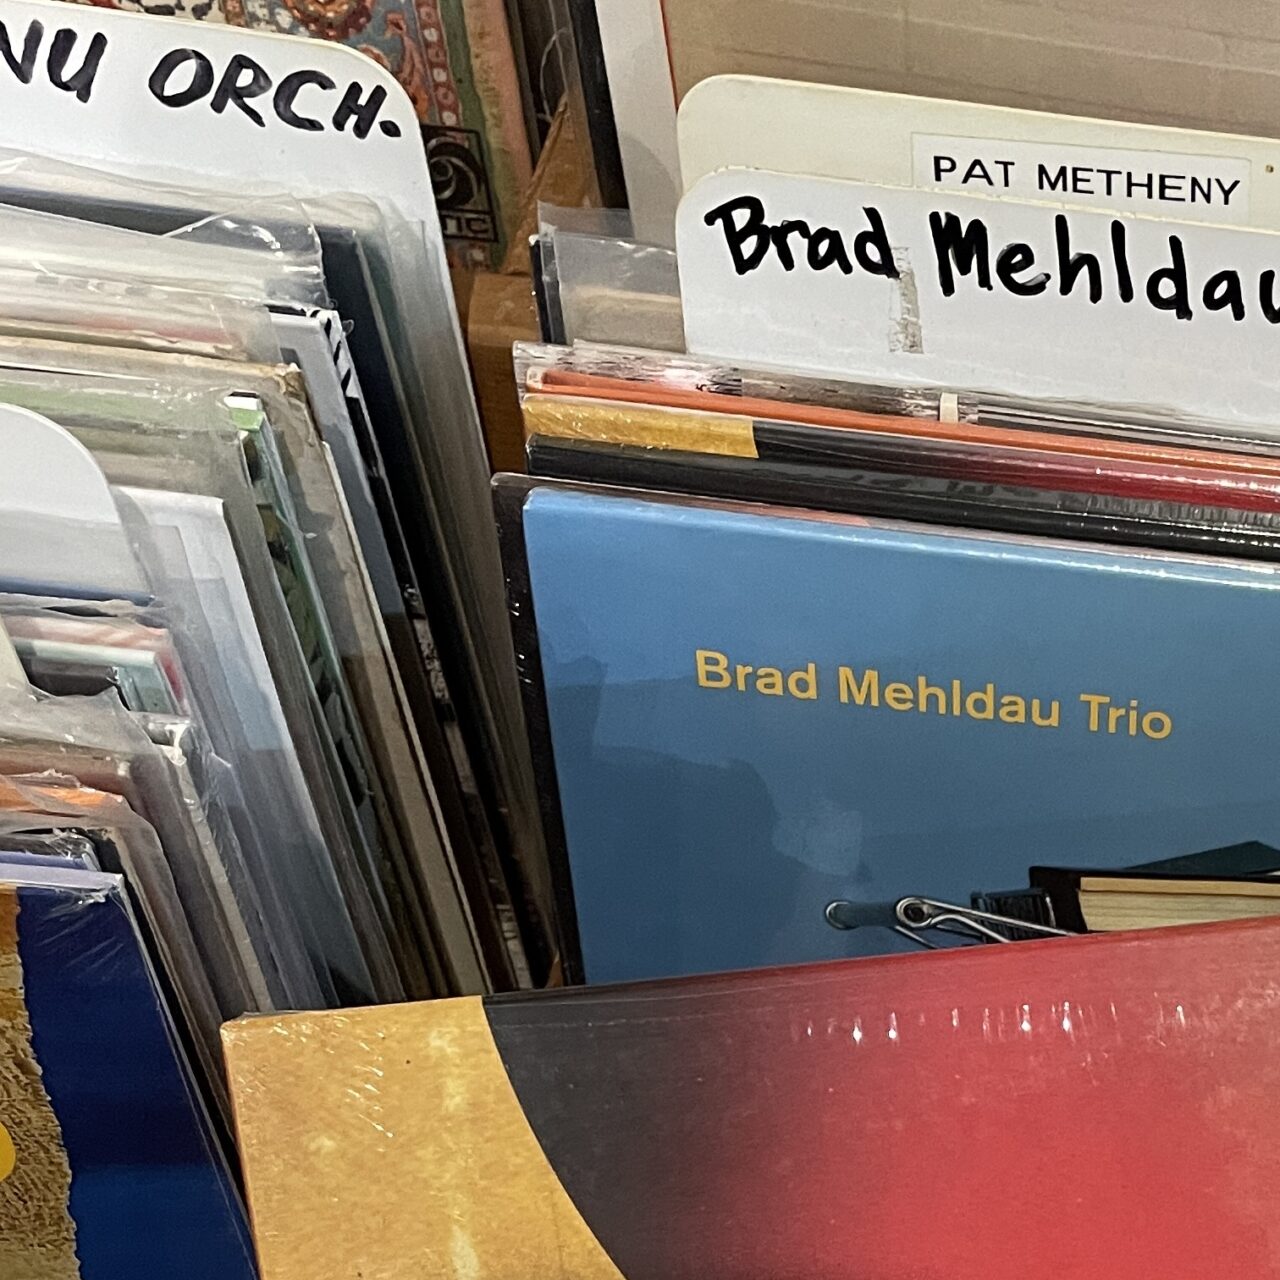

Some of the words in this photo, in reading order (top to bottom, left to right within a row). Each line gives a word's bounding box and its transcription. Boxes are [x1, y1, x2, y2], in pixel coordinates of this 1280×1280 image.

[148, 48, 402, 140] ORCH.
[932, 155, 1016, 188] PAT
[1037, 164, 1241, 206] METHENY
[704, 195, 902, 279] Brad
[695, 649, 818, 700] Brad
[838, 666, 1060, 727] Mehldau
[1080, 692, 1173, 740] Trio
